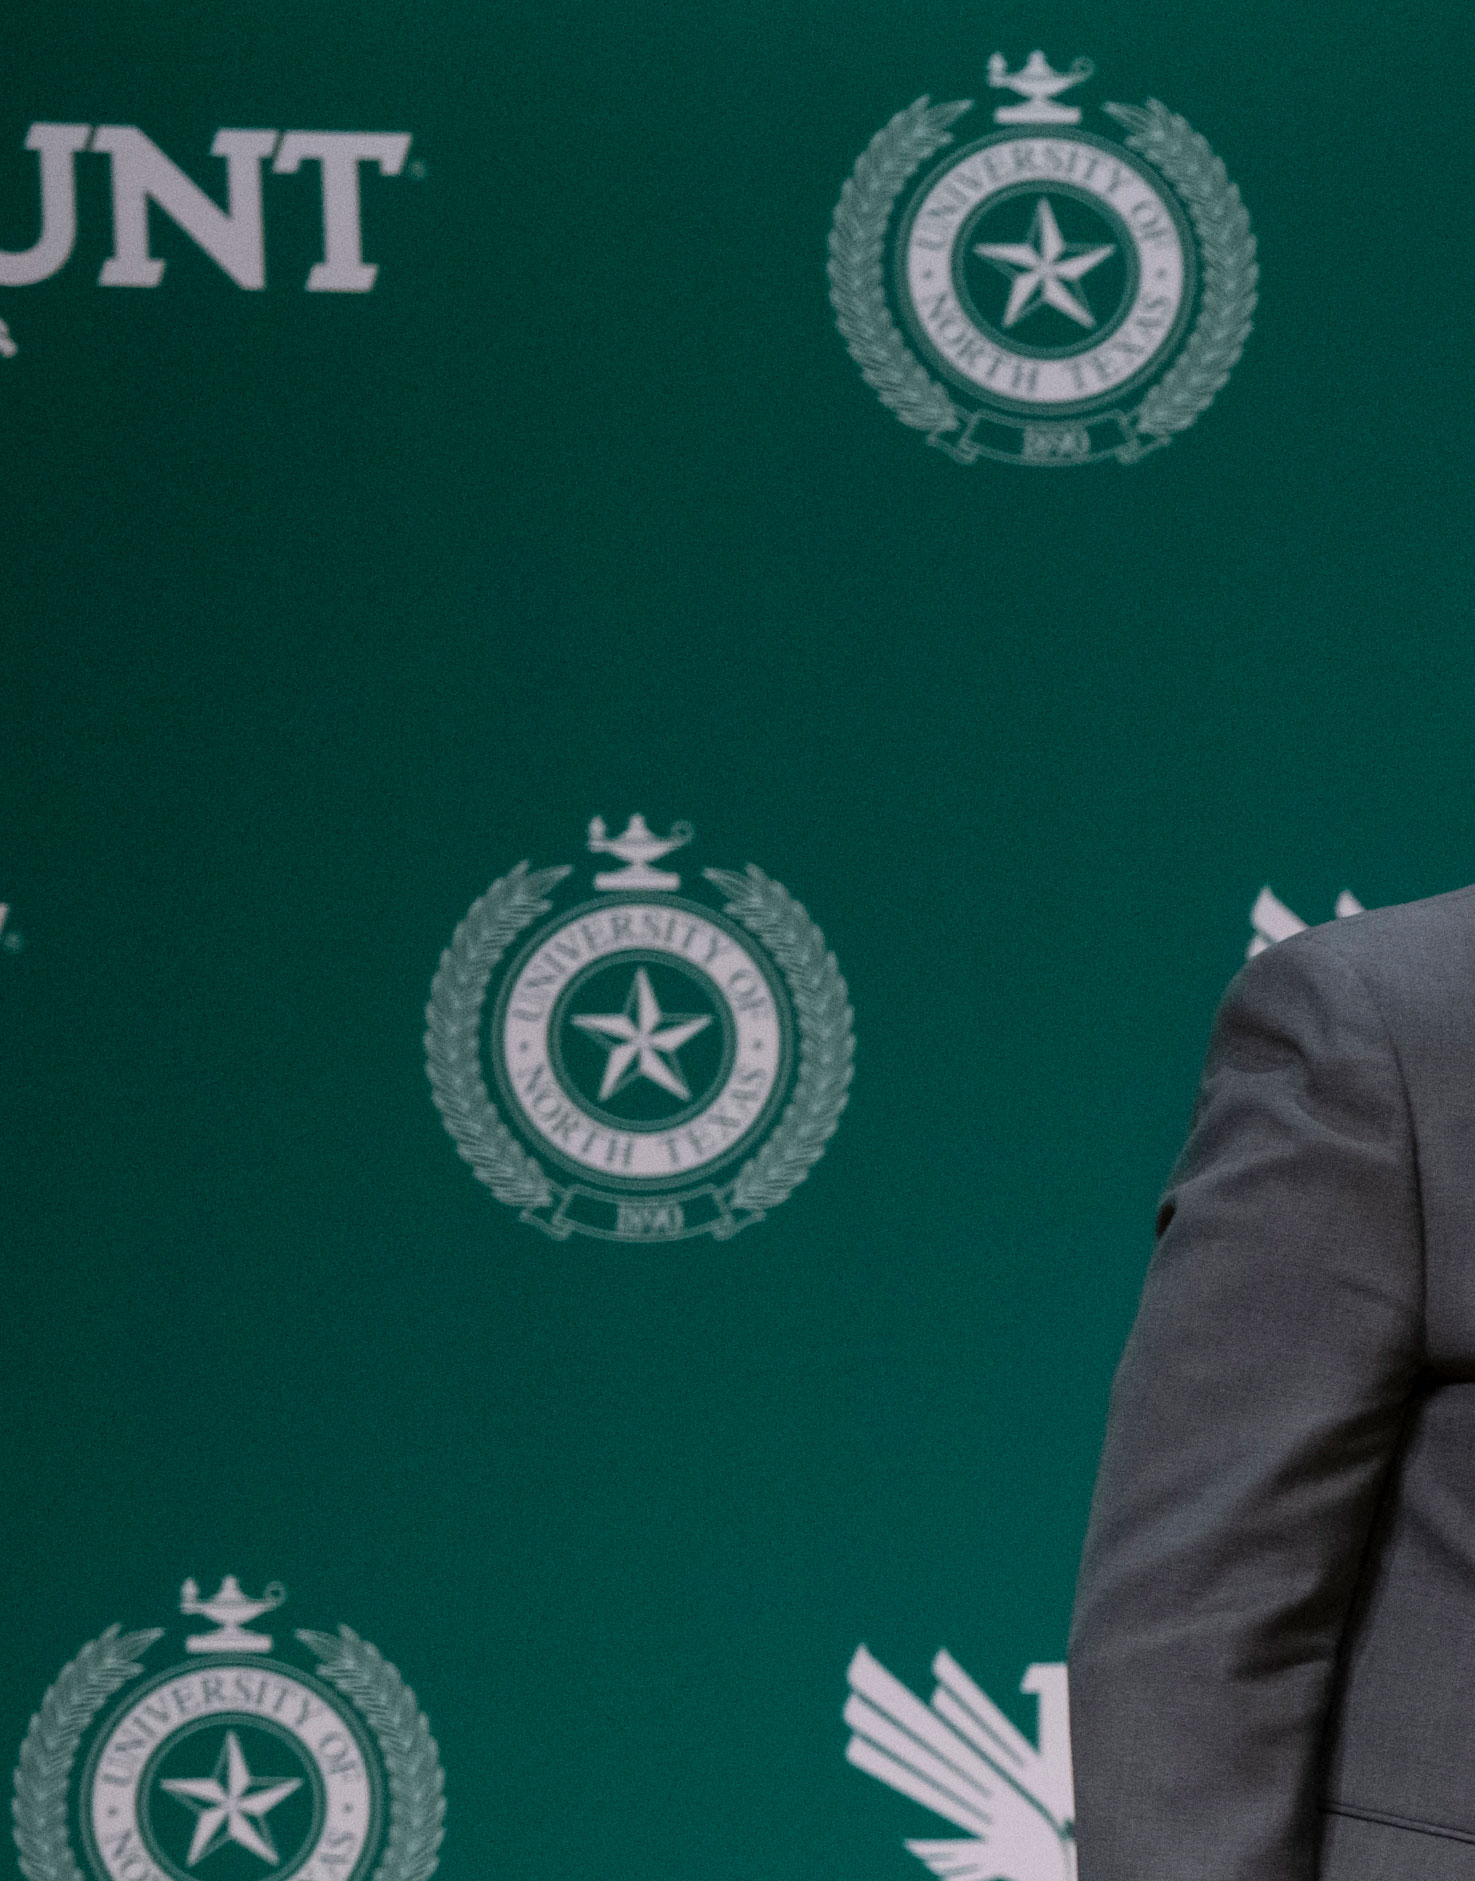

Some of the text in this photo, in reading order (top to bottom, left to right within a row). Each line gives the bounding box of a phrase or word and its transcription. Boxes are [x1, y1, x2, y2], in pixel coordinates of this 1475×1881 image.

[915, 145, 1170, 250] UNIVERSITY OF
[916, 293, 1170, 393] NORTH TEXAS
[512, 913, 769, 1021] UNIVERSITY OF
[514, 1064, 768, 1168] NORTH TEXAS
[101, 1676, 362, 1785] UNIVERSITY OF
